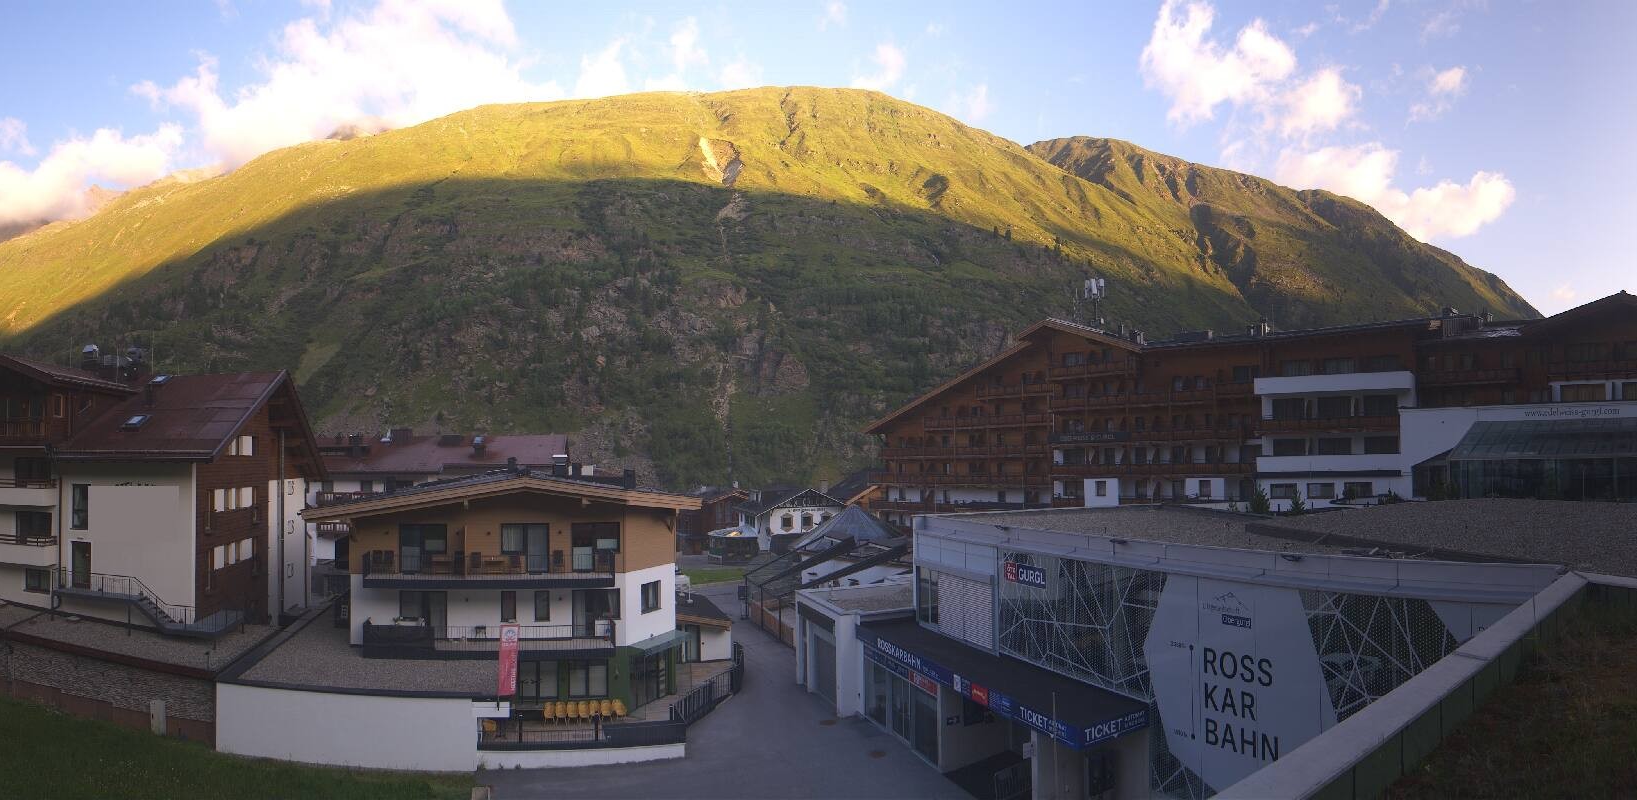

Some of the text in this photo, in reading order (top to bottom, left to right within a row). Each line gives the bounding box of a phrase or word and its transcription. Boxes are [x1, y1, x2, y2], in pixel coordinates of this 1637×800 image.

[1018, 567, 1046, 585] GURGL
[877, 637, 921, 670] ROSSKARBAHN
[1203, 647, 1273, 687] ROSS
[1019, 706, 1049, 730] TICKET
[1204, 682, 1257, 721] KAR
[1084, 718, 1123, 742] TICKET
[1205, 718, 1279, 762] BAHN
